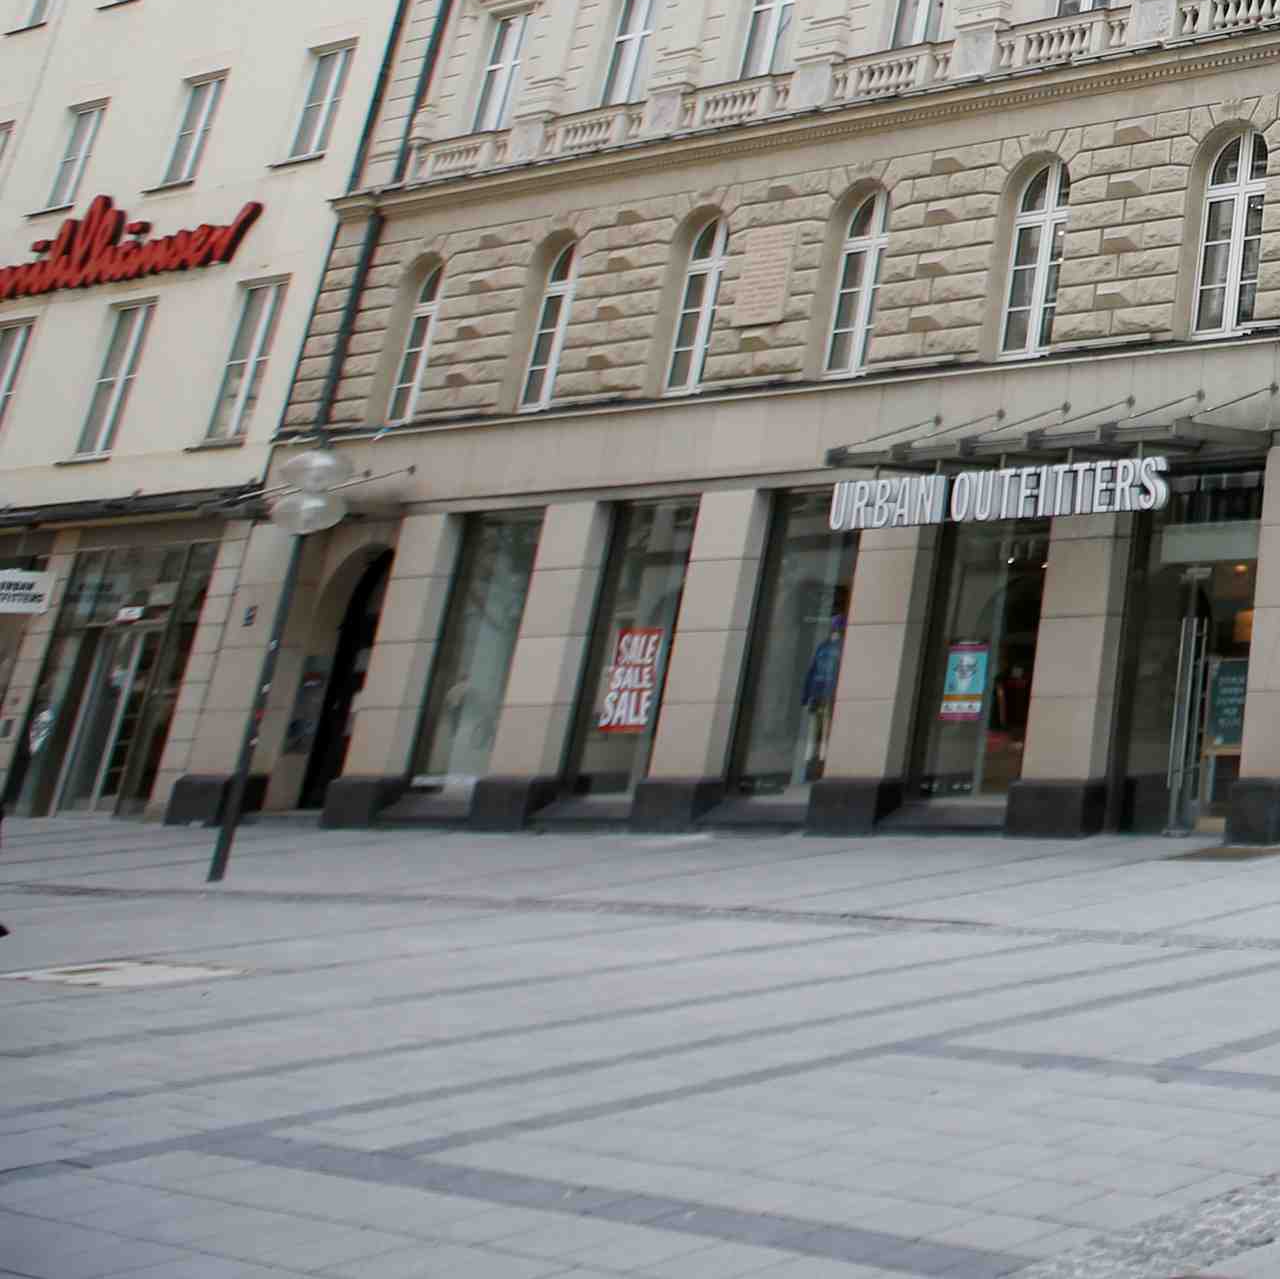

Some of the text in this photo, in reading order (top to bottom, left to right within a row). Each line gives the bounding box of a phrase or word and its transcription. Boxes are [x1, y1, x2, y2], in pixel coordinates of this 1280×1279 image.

[830, 456, 1170, 530] URBAN OUTFITTERS
[618, 633, 660, 663] SALE
[610, 666, 654, 690] SALE
[599, 691, 652, 727] SALE
